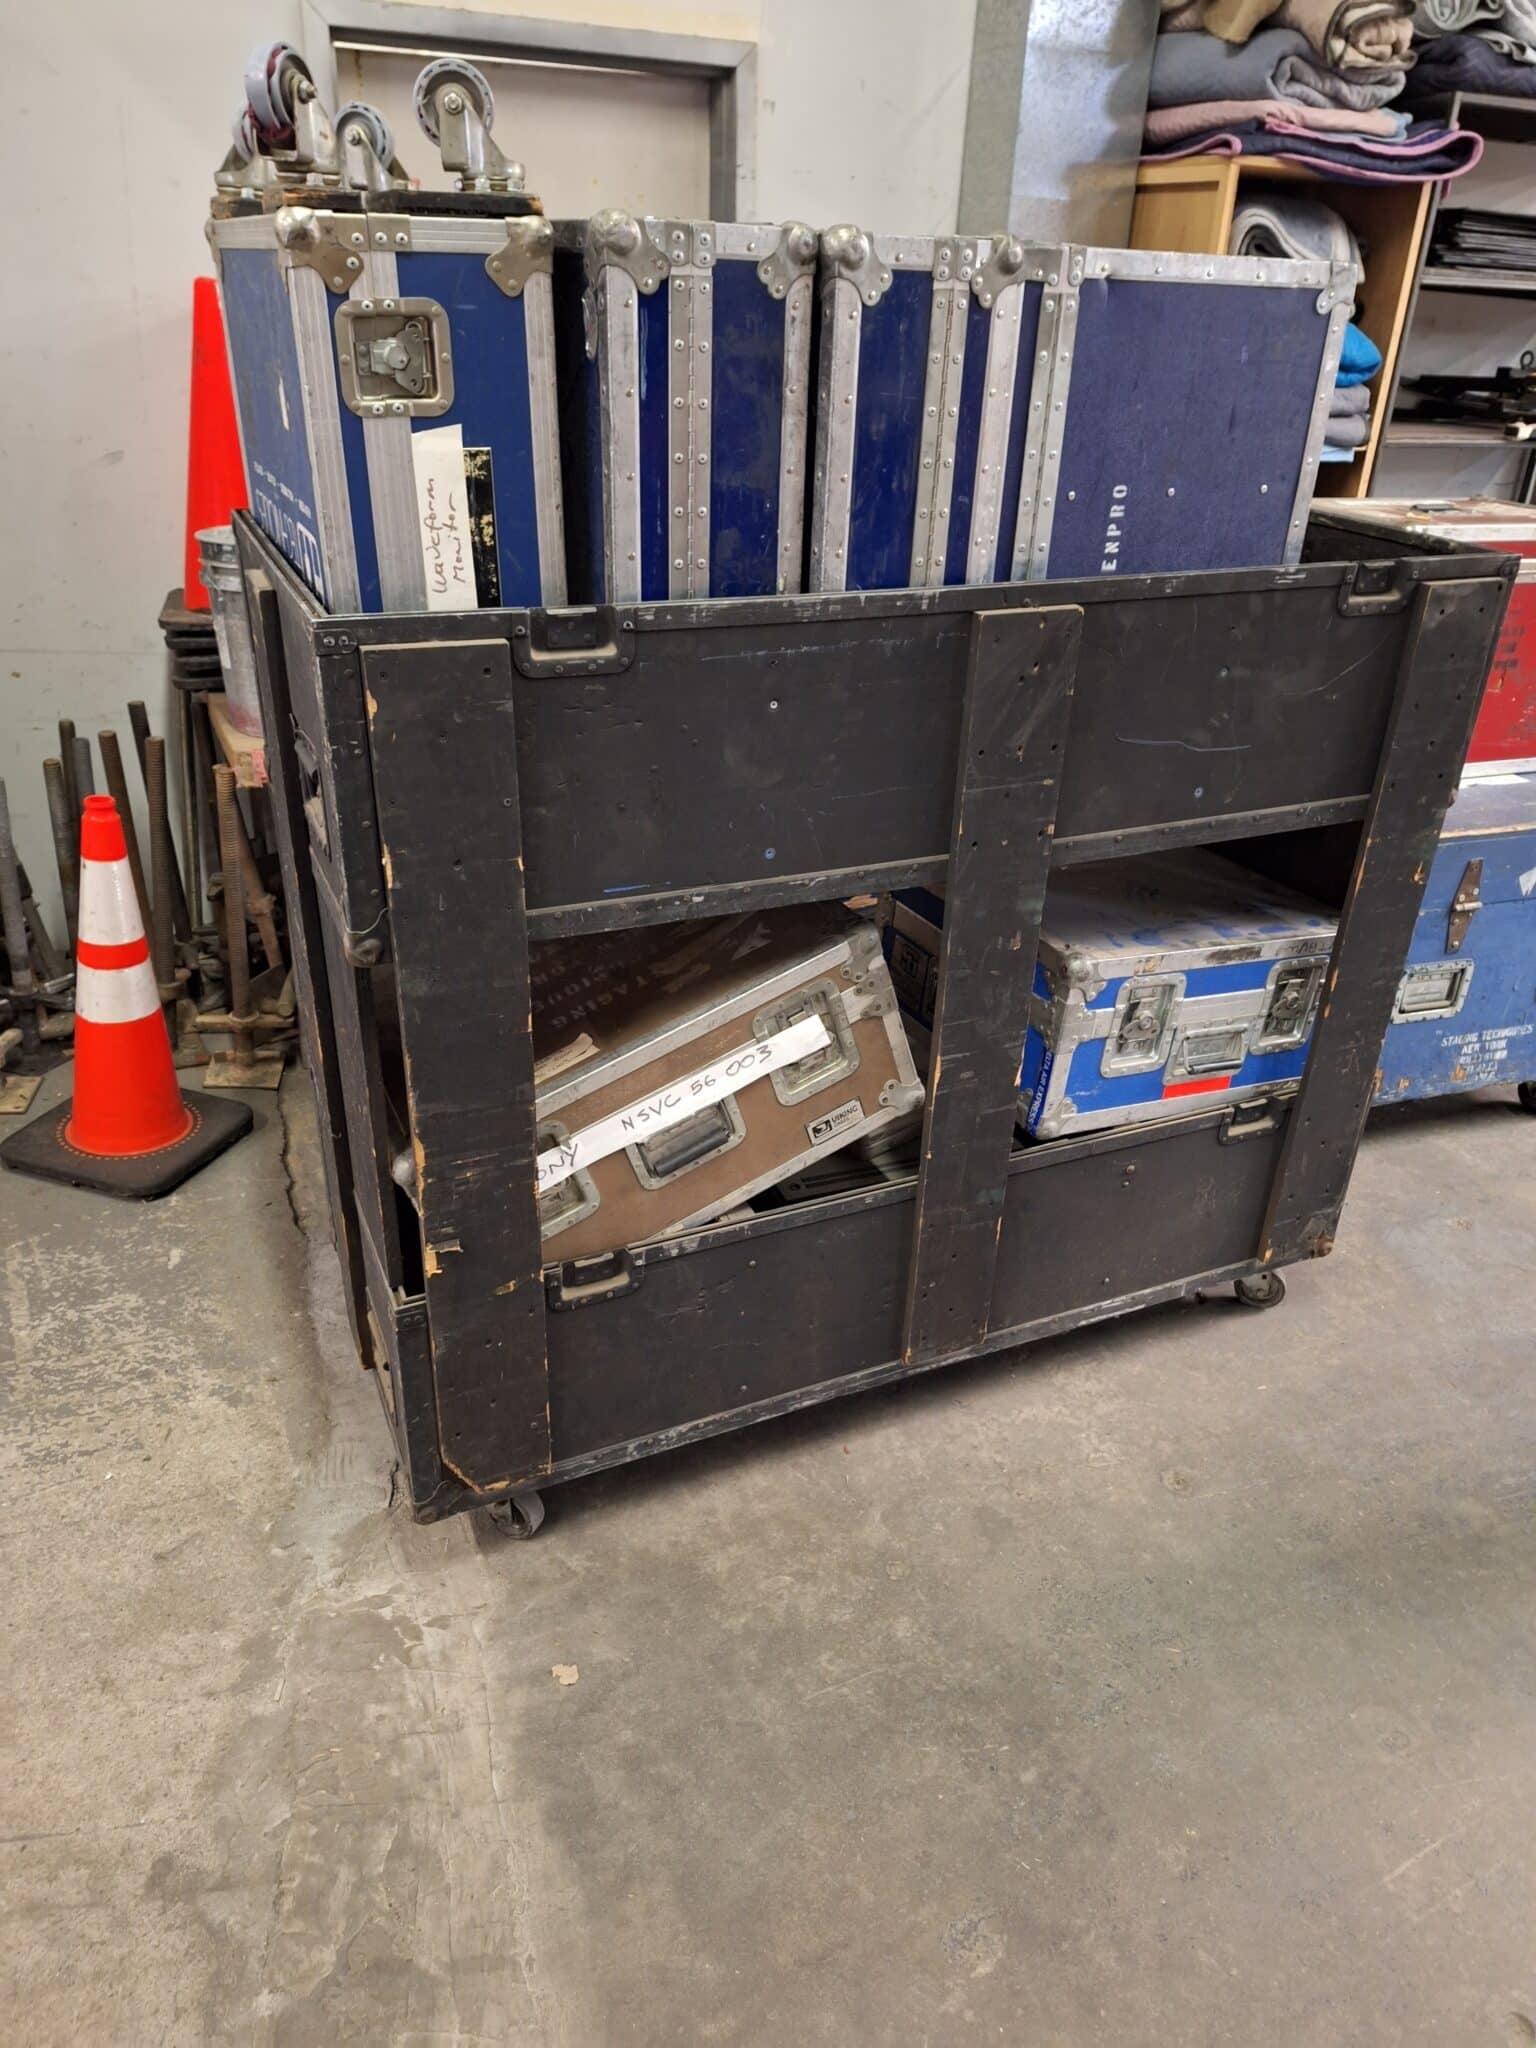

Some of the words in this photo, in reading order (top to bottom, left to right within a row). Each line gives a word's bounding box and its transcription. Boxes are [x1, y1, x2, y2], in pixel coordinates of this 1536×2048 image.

[442, 491, 466, 584] Monitor
[1101, 485, 1128, 572] ENPRO
[690, 1075, 717, 1096] 56
[726, 1044, 773, 1077] 003
